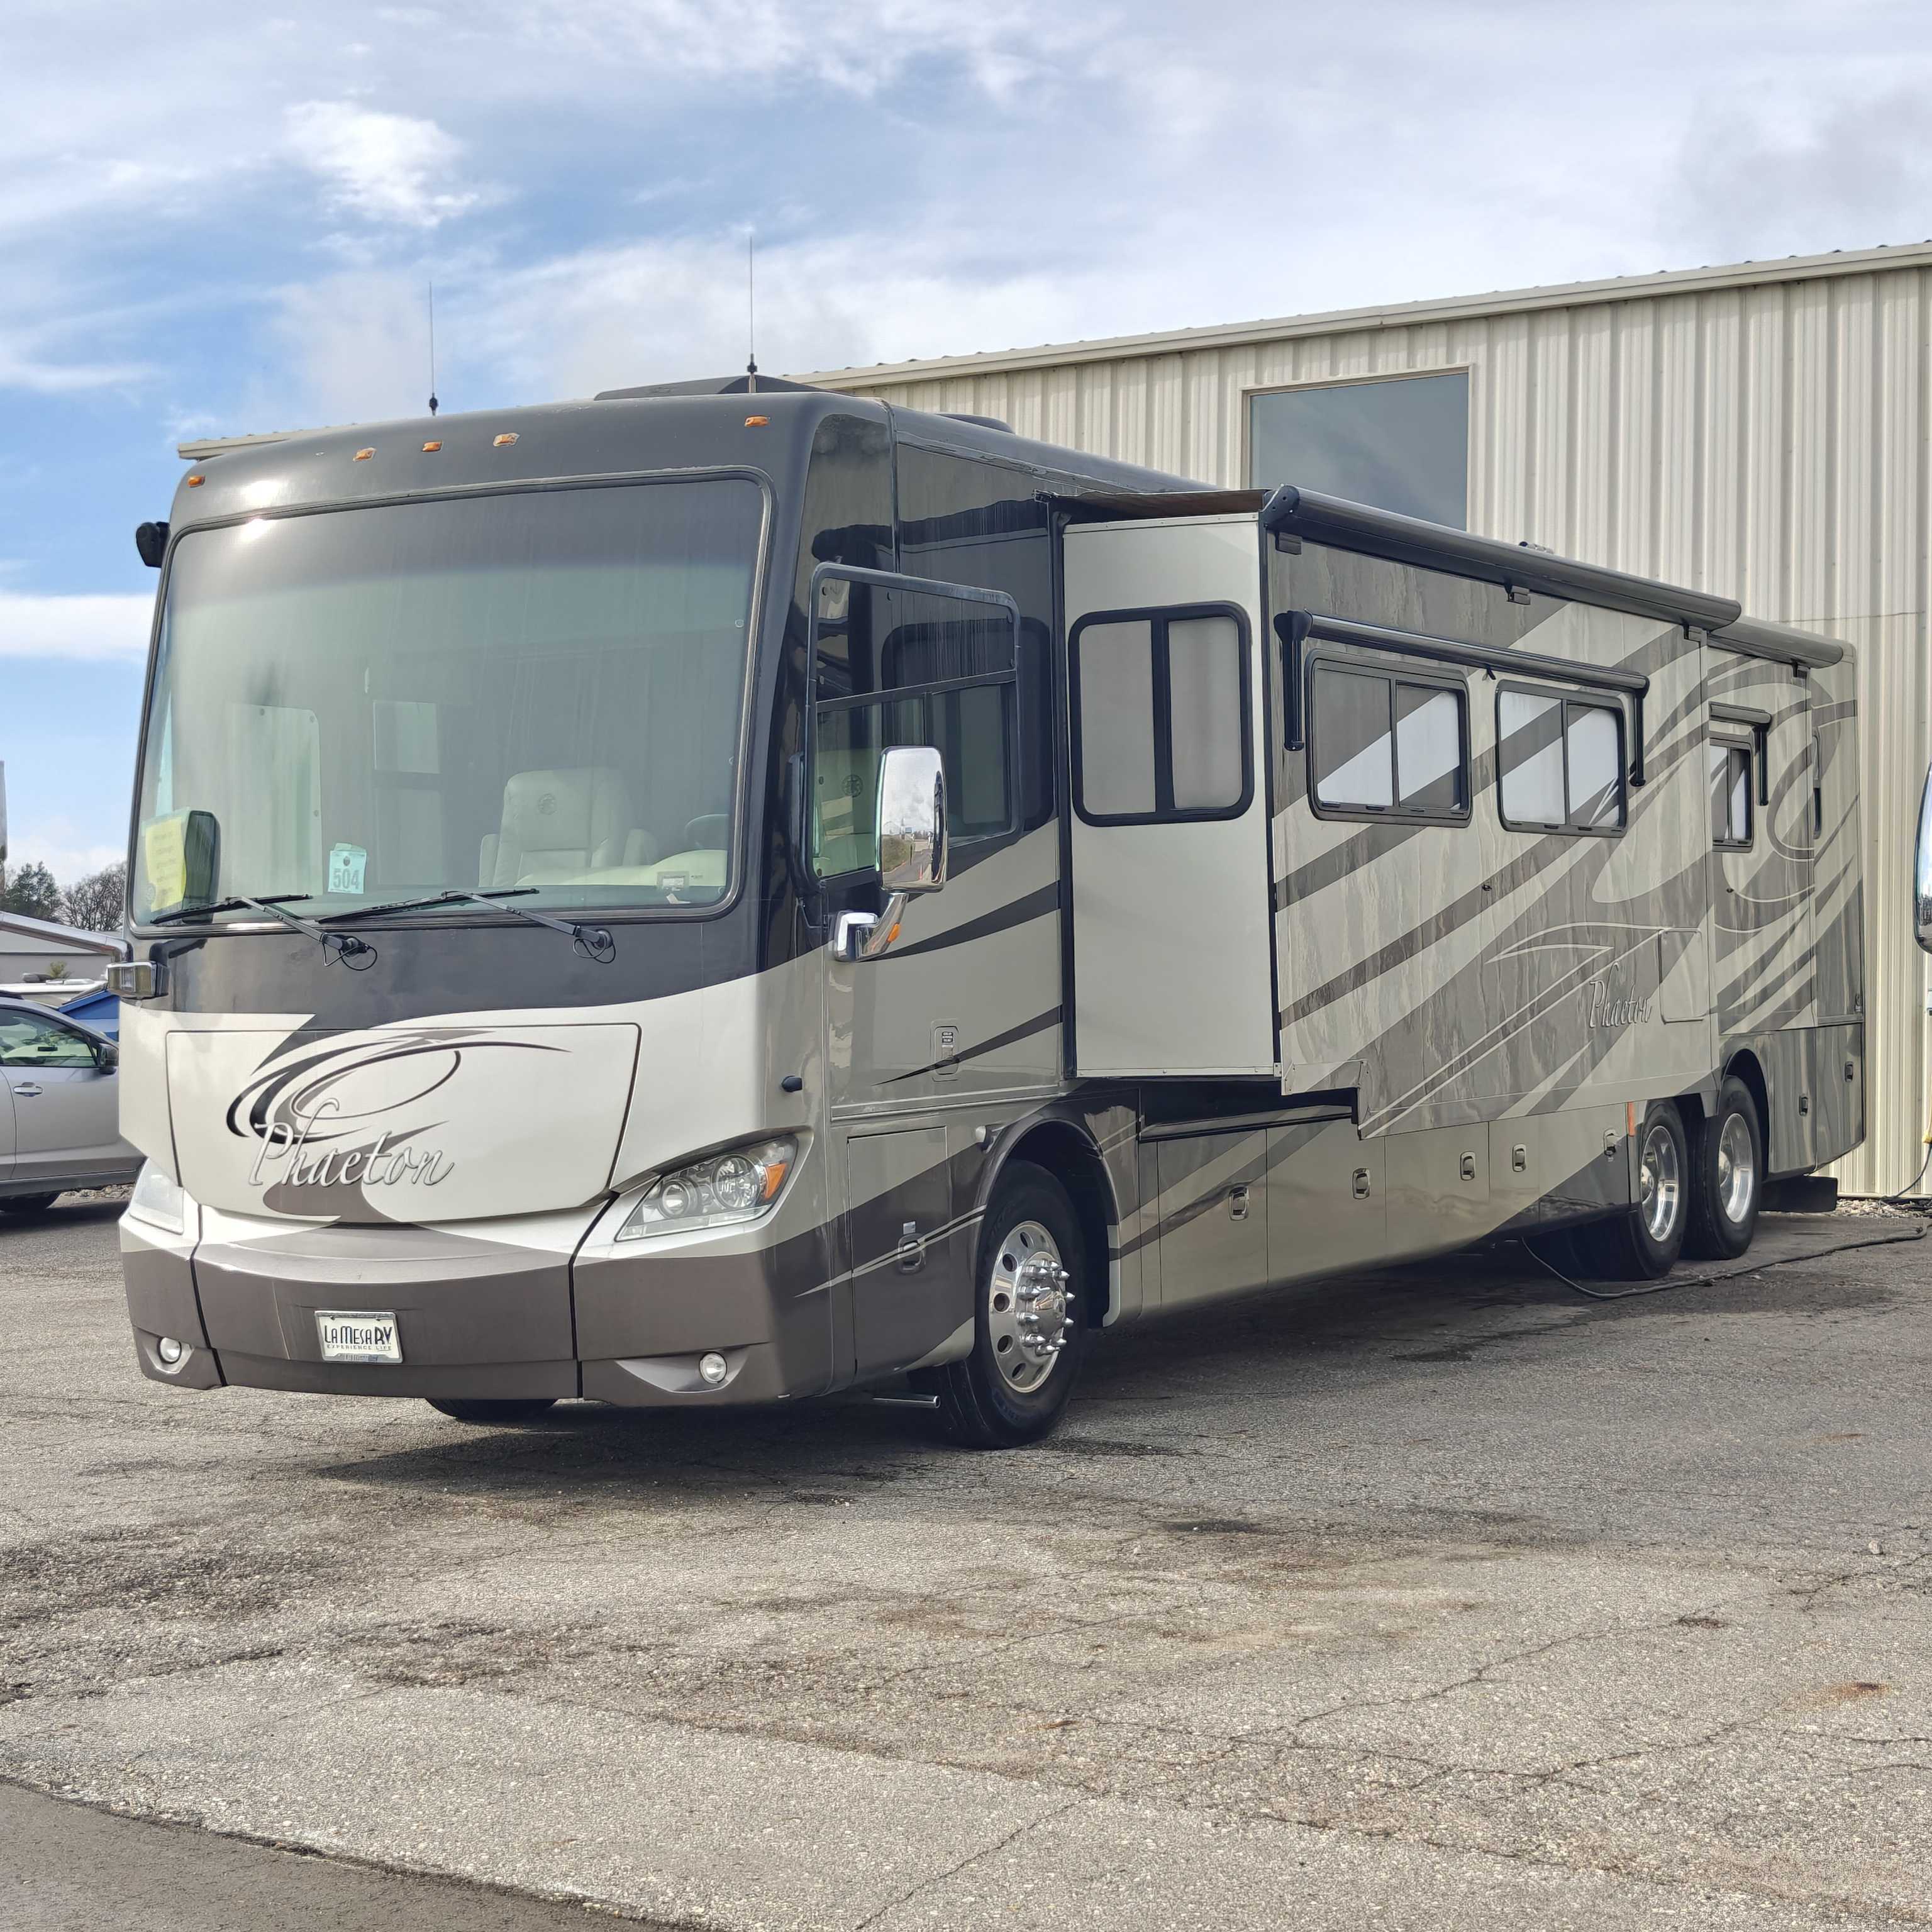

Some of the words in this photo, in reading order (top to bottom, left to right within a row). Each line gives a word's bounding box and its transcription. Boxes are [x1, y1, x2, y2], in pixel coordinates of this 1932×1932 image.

[333, 868, 360, 890] 504
[1589, 962, 1653, 1028] Phaeton
[248, 1097, 455, 1187] Phaeton
